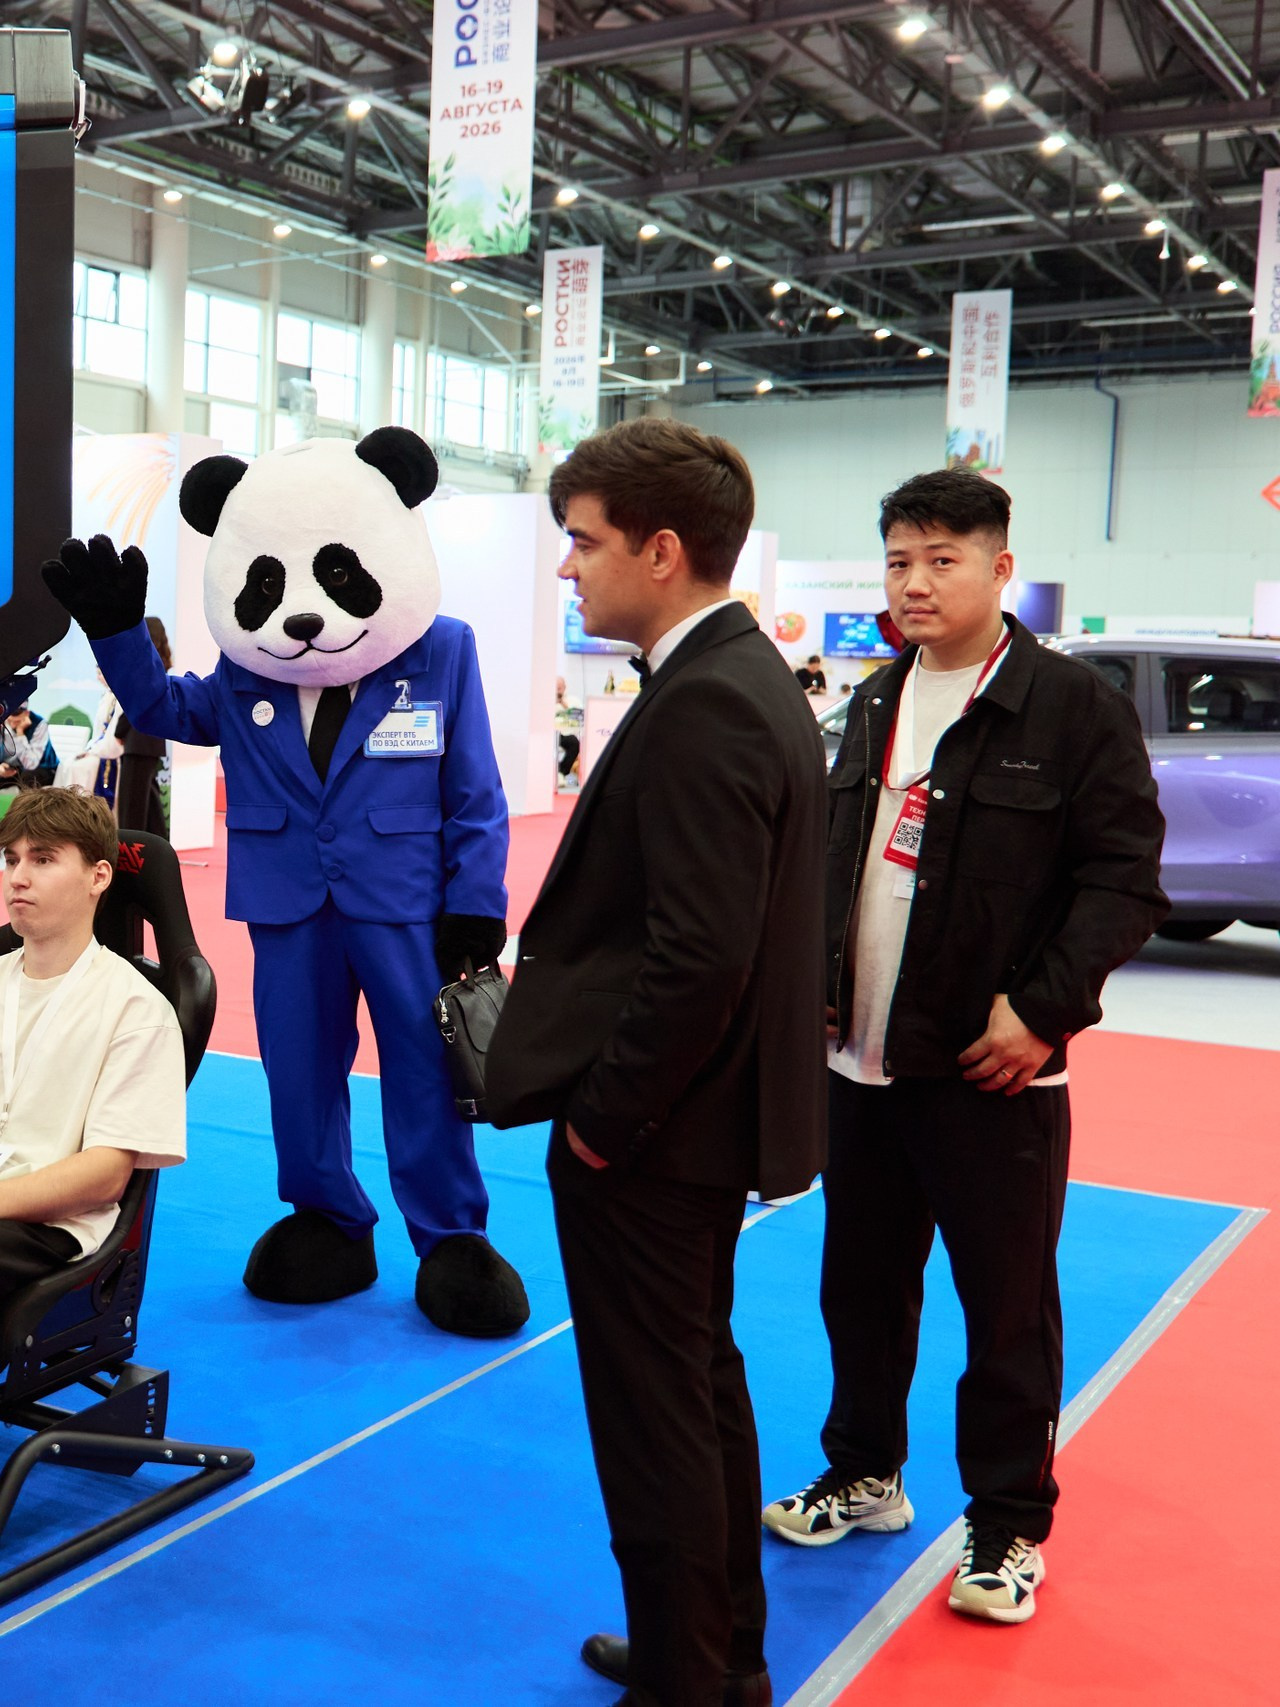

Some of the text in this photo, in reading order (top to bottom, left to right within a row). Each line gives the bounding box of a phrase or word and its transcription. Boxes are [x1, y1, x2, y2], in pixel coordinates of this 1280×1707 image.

[440, 98, 523, 121] АВГУСТА
[459, 121, 502, 139] 2026
[554, 258, 571, 349] РОСТКИ
[372, 731, 417, 739] ЭКСПЕРТ ВТБ
[384, 740, 399, 748] ВЭД
[406, 739, 435, 747] КИТАЕМ
[909, 805, 927, 817] ТЕХН
[911, 814, 926, 823] ПЕР
